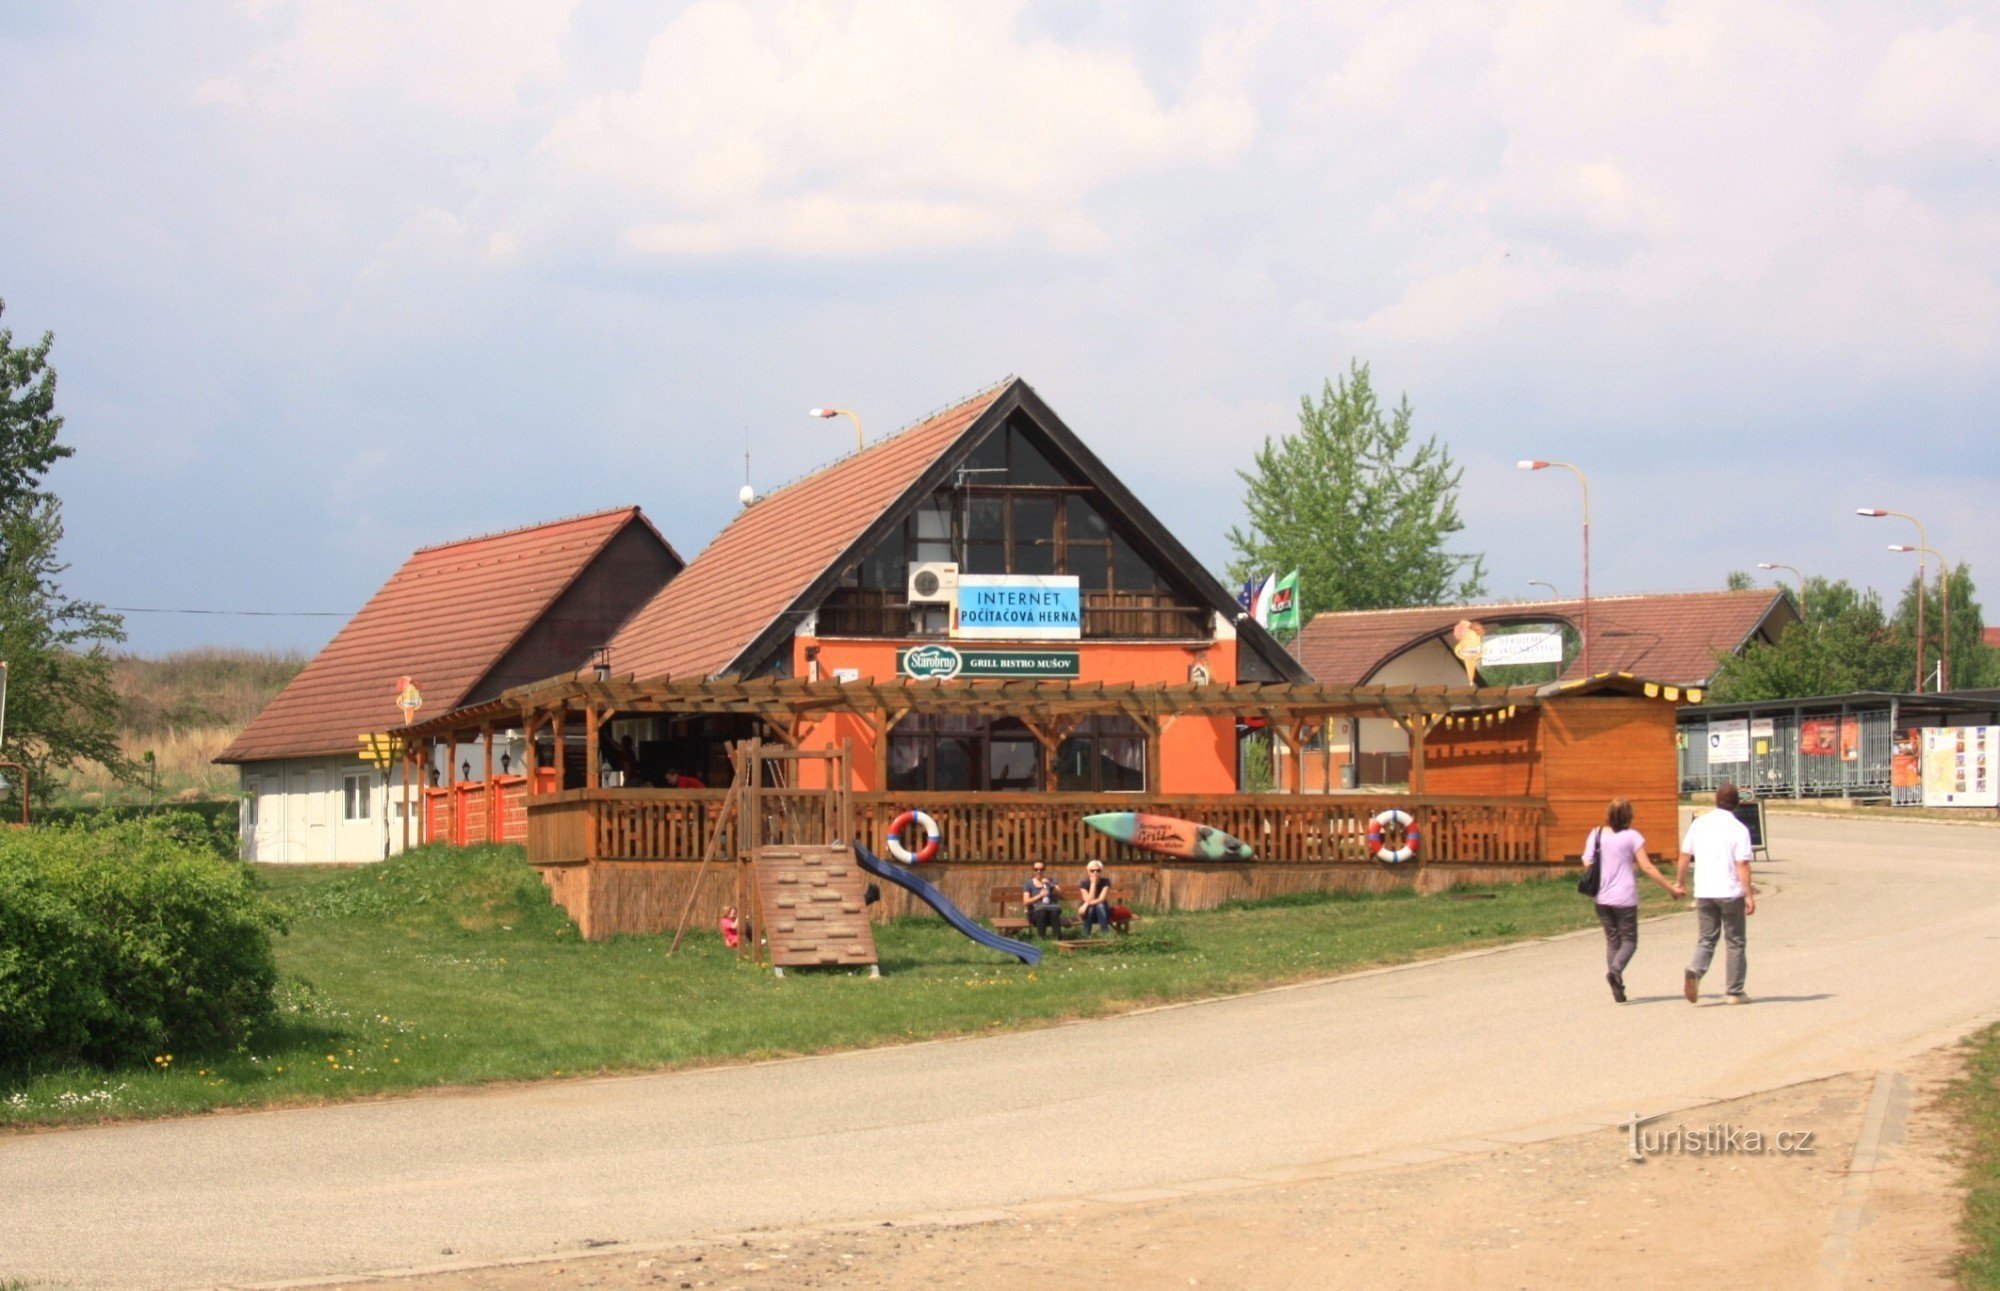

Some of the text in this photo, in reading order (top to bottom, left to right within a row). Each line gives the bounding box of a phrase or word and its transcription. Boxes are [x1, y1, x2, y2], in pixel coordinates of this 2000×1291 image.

[977, 592, 1061, 606] INTERNET
[960, 607, 1078, 623] POČÍTAČOVÁ HERNA
[911, 651, 956, 674] Starobrno
[970, 656, 1072, 669] GRILL BISTRO MUŠOV
